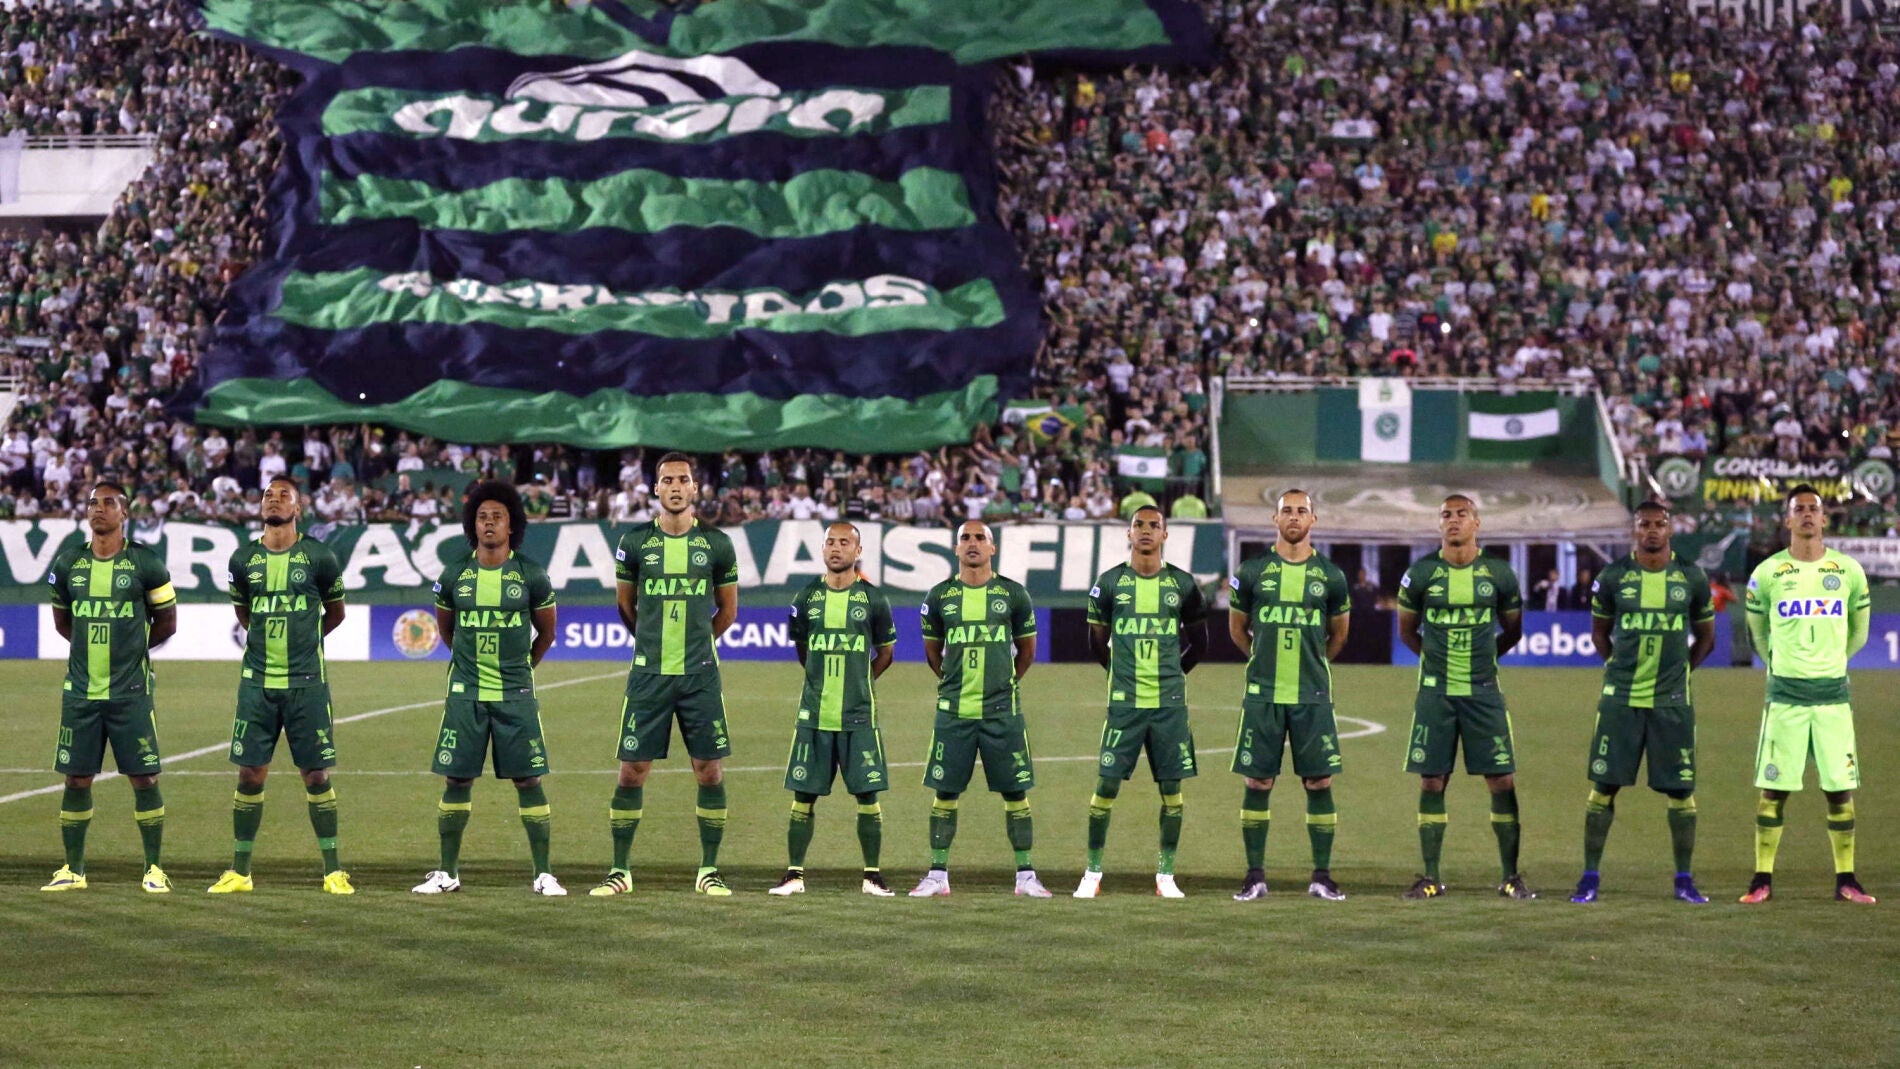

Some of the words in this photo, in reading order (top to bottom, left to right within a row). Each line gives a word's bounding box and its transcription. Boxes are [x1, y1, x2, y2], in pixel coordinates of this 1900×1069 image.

[645, 578, 707, 596] CAIXA
[669, 602, 679, 622] 4
[1258, 605, 1321, 626] CAIXA
[1426, 606, 1492, 625] CAIXA
[1778, 599, 1843, 617] CAIXA
[268, 619, 286, 639] 27
[1115, 617, 1177, 635] CAIXA
[1621, 611, 1684, 631] CAIXA
[91, 624, 108, 645] 20
[1284, 629, 1294, 650] 5
[479, 635, 497, 655] 25
[1140, 640, 1154, 660] 17
[1645, 637, 1655, 656] 6
[828, 657, 840, 677] 11
[969, 649, 978, 669] 8
[236, 718, 248, 739] 27
[626, 712, 636, 732] 4
[60, 725, 73, 747] 20
[441, 728, 457, 749] 25
[1105, 728, 1122, 748] 17
[1244, 728, 1254, 748] 5
[1415, 724, 1428, 746] 21
[796, 742, 809, 763] 11
[935, 741, 944, 760] 8
[1599, 735, 1609, 756] 6
